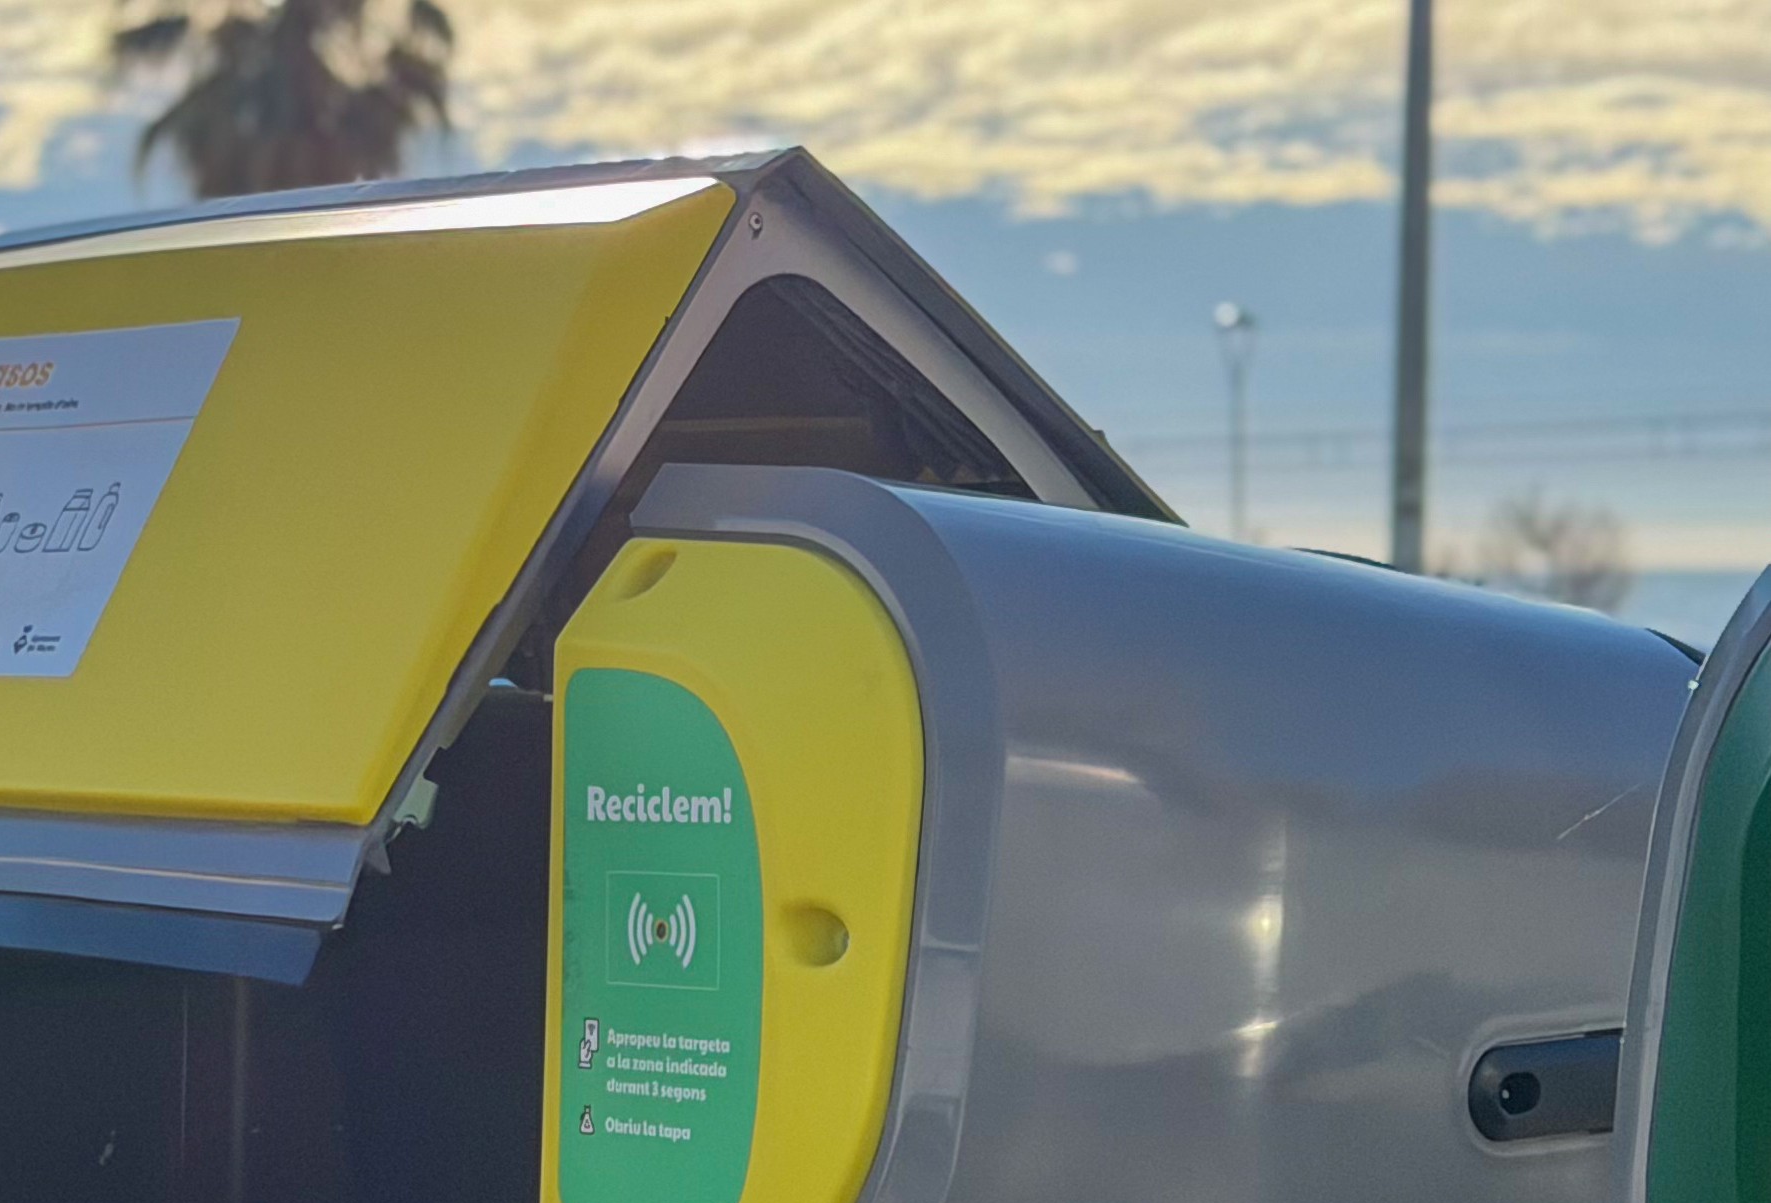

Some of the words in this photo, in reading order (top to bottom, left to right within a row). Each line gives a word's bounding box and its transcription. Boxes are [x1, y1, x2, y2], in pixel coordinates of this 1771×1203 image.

[587, 784, 732, 824] Reciclem!
[607, 1028, 661, 1049] Apropeu
[663, 1033, 676, 1049] la
[679, 1036, 730, 1055] targeta
[606, 1056, 615, 1068] a
[617, 1053, 630, 1069] la
[632, 1058, 664, 1073] zona
[666, 1056, 727, 1077] indicada
[606, 1078, 650, 1095] durant
[652, 1081, 659, 1097] 3
[661, 1086, 706, 1103] segons
[605, 1117, 641, 1135] Obriu
[643, 1120, 656, 1137] la
[659, 1123, 691, 1142] tapa
